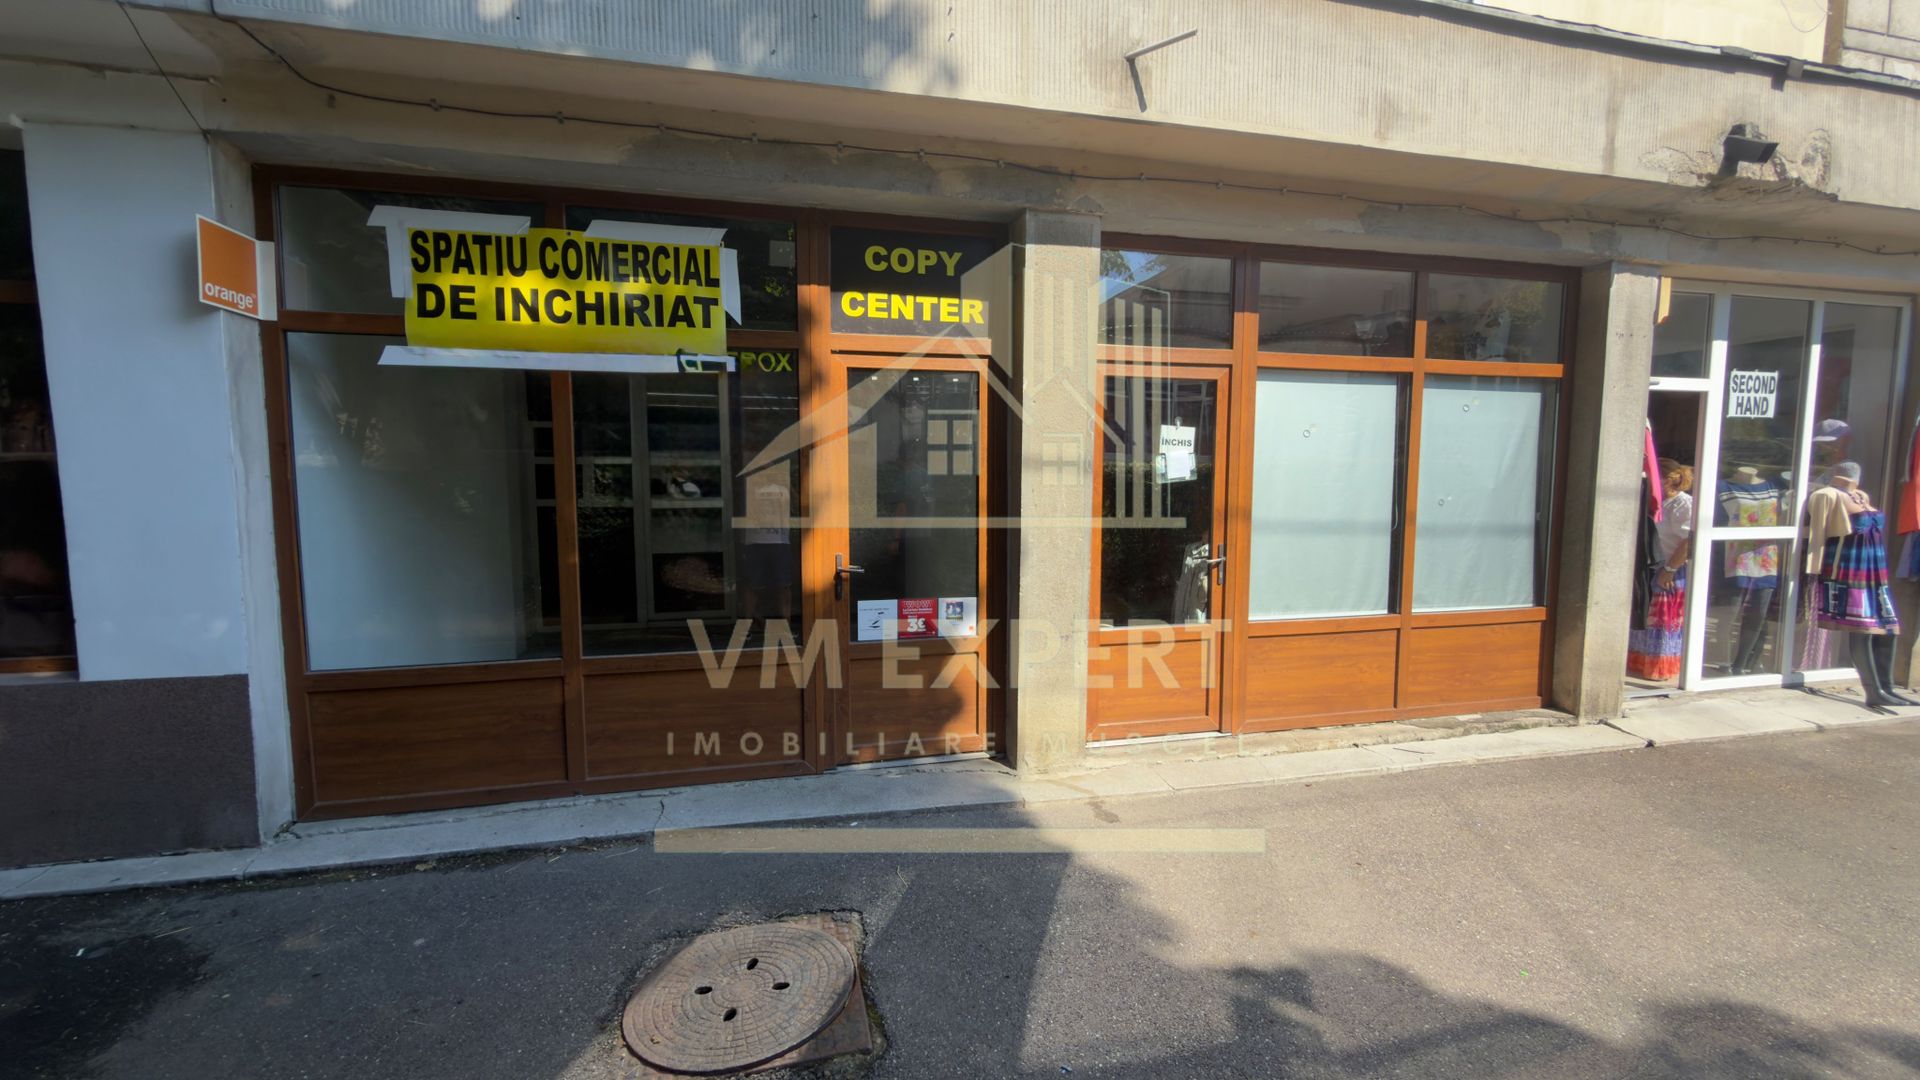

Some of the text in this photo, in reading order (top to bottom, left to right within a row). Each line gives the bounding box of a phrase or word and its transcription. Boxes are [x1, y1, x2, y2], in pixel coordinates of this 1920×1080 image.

[411, 230, 720, 288] SPATIU COMERCIAL
[864, 245, 962, 277] COPY
[205, 282, 254, 310] orange
[417, 283, 719, 329] DE INCHIRIAT
[840, 291, 985, 324] CENTER
[1731, 374, 1776, 394] SECOND
[1735, 395, 1769, 416] HAND
